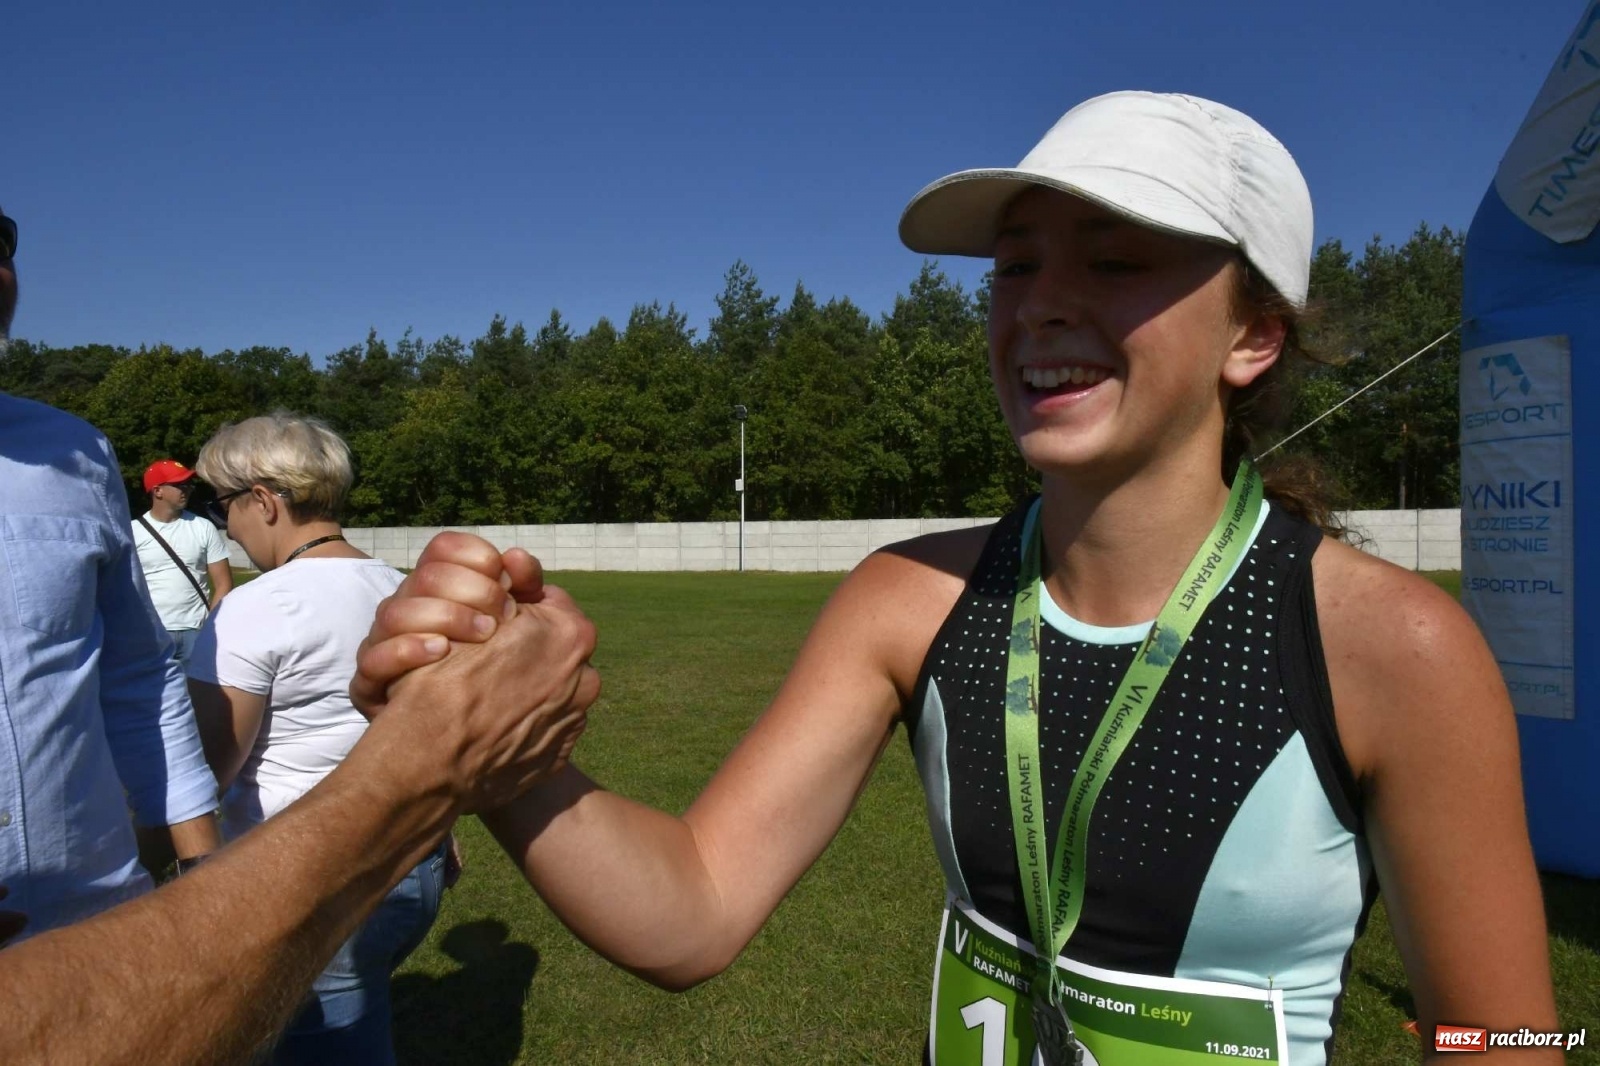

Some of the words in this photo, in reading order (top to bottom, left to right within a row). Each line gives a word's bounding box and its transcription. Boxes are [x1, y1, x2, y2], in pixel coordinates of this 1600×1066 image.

[1463, 403, 1564, 430] ESPORT
[1214, 522, 1240, 553] Leśny
[1178, 551, 1222, 612] RAFAMET
[1126, 685, 1148, 704] VI
[1089, 703, 1133, 770] Kuźniański
[1018, 754, 1034, 824] RAFAMET
[1022, 828, 1038, 868] Leśny
[1059, 849, 1075, 891] Leśny
[973, 955, 1031, 994] RAFAMET
[975, 938, 1023, 973] Kuźniań
[1060, 980, 1135, 1015] łmaraton
[1141, 1003, 1193, 1027] Leśny
[1204, 1041, 1271, 1060] 11.09.2021
